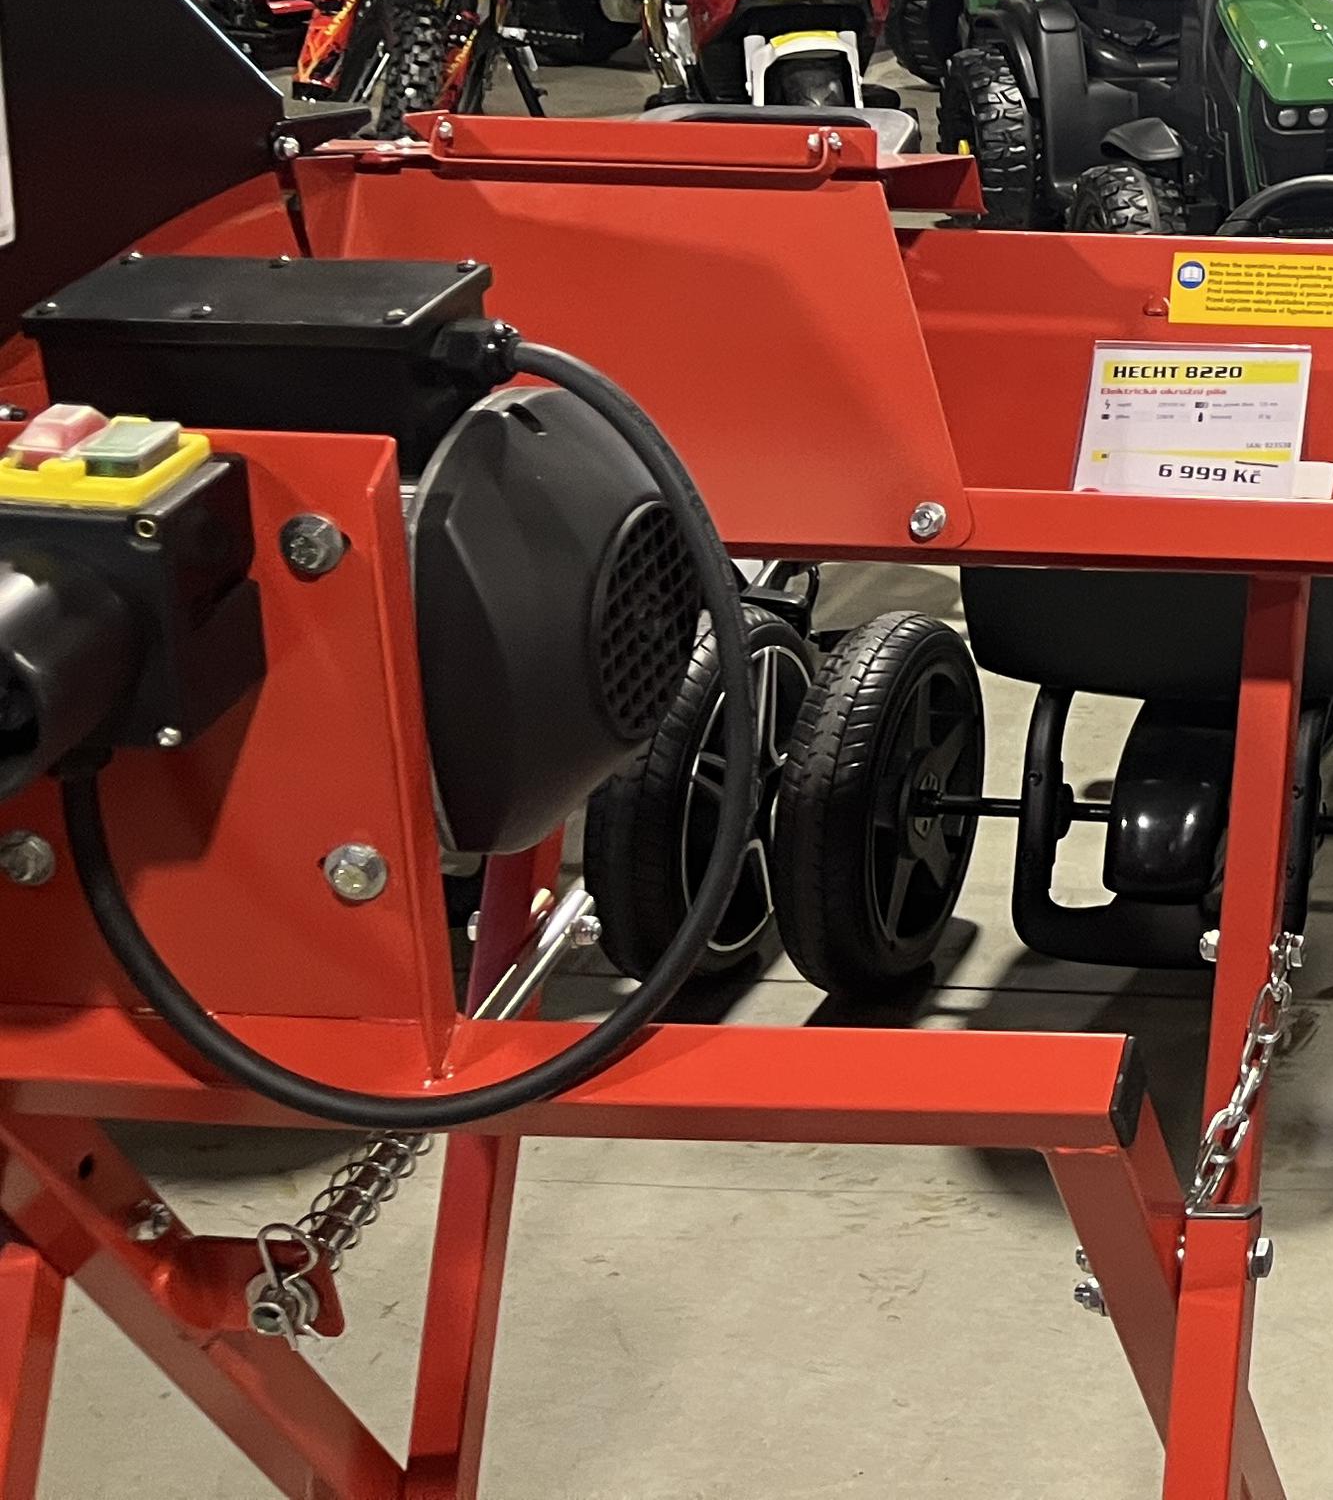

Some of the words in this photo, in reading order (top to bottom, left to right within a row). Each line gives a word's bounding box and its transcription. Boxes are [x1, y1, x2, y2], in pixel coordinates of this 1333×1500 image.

[1113, 365, 1180, 379] HECHT
[1184, 365, 1243, 379] 8220
[1101, 387, 1157, 396] Elektrická
[1158, 463, 1174, 478] 6
[1179, 464, 1227, 482] 999
[1232, 469, 1262, 485] Kč
